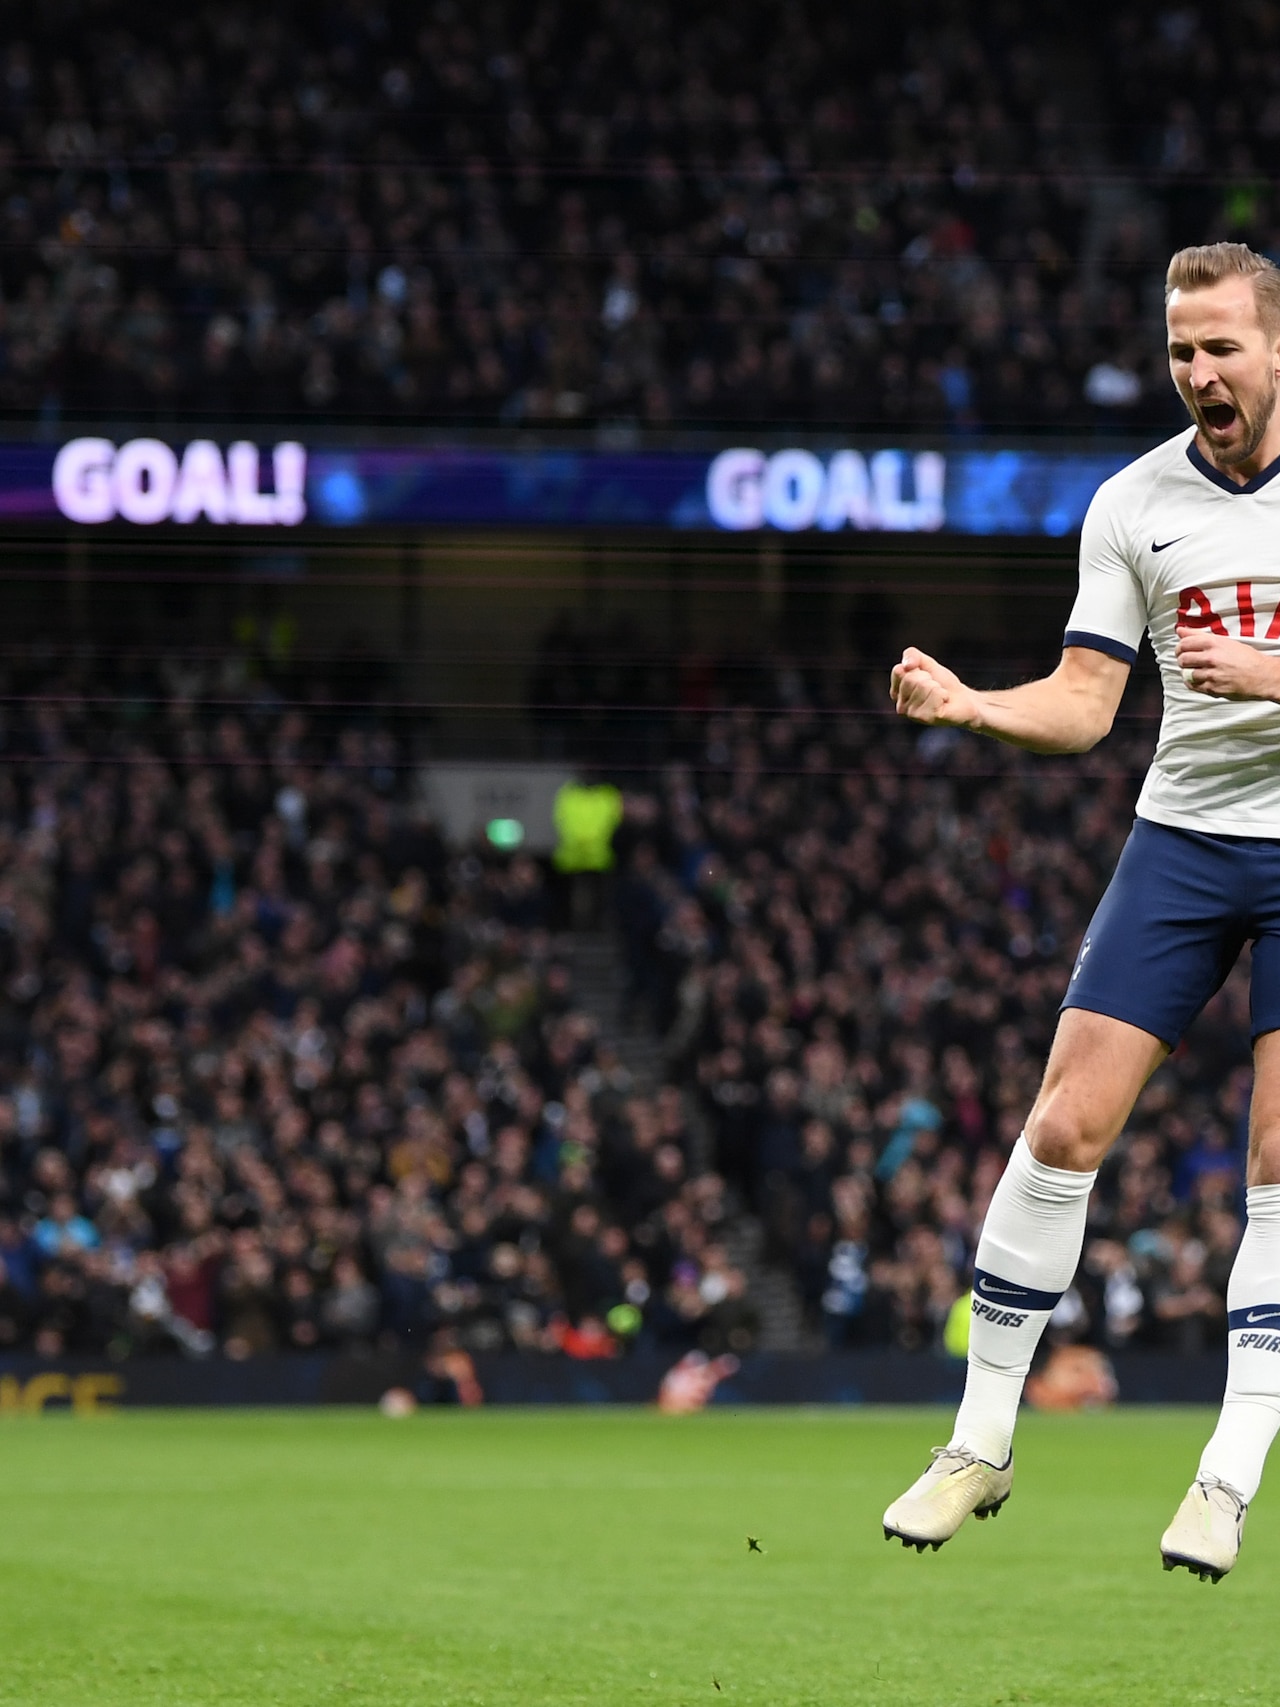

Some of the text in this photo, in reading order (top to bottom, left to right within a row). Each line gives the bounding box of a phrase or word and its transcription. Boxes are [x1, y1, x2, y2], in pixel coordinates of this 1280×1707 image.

[52, 436, 306, 525] GOAL!
[706, 447, 946, 532] GOAL!
[971, 1299, 1030, 1328] SPURS
